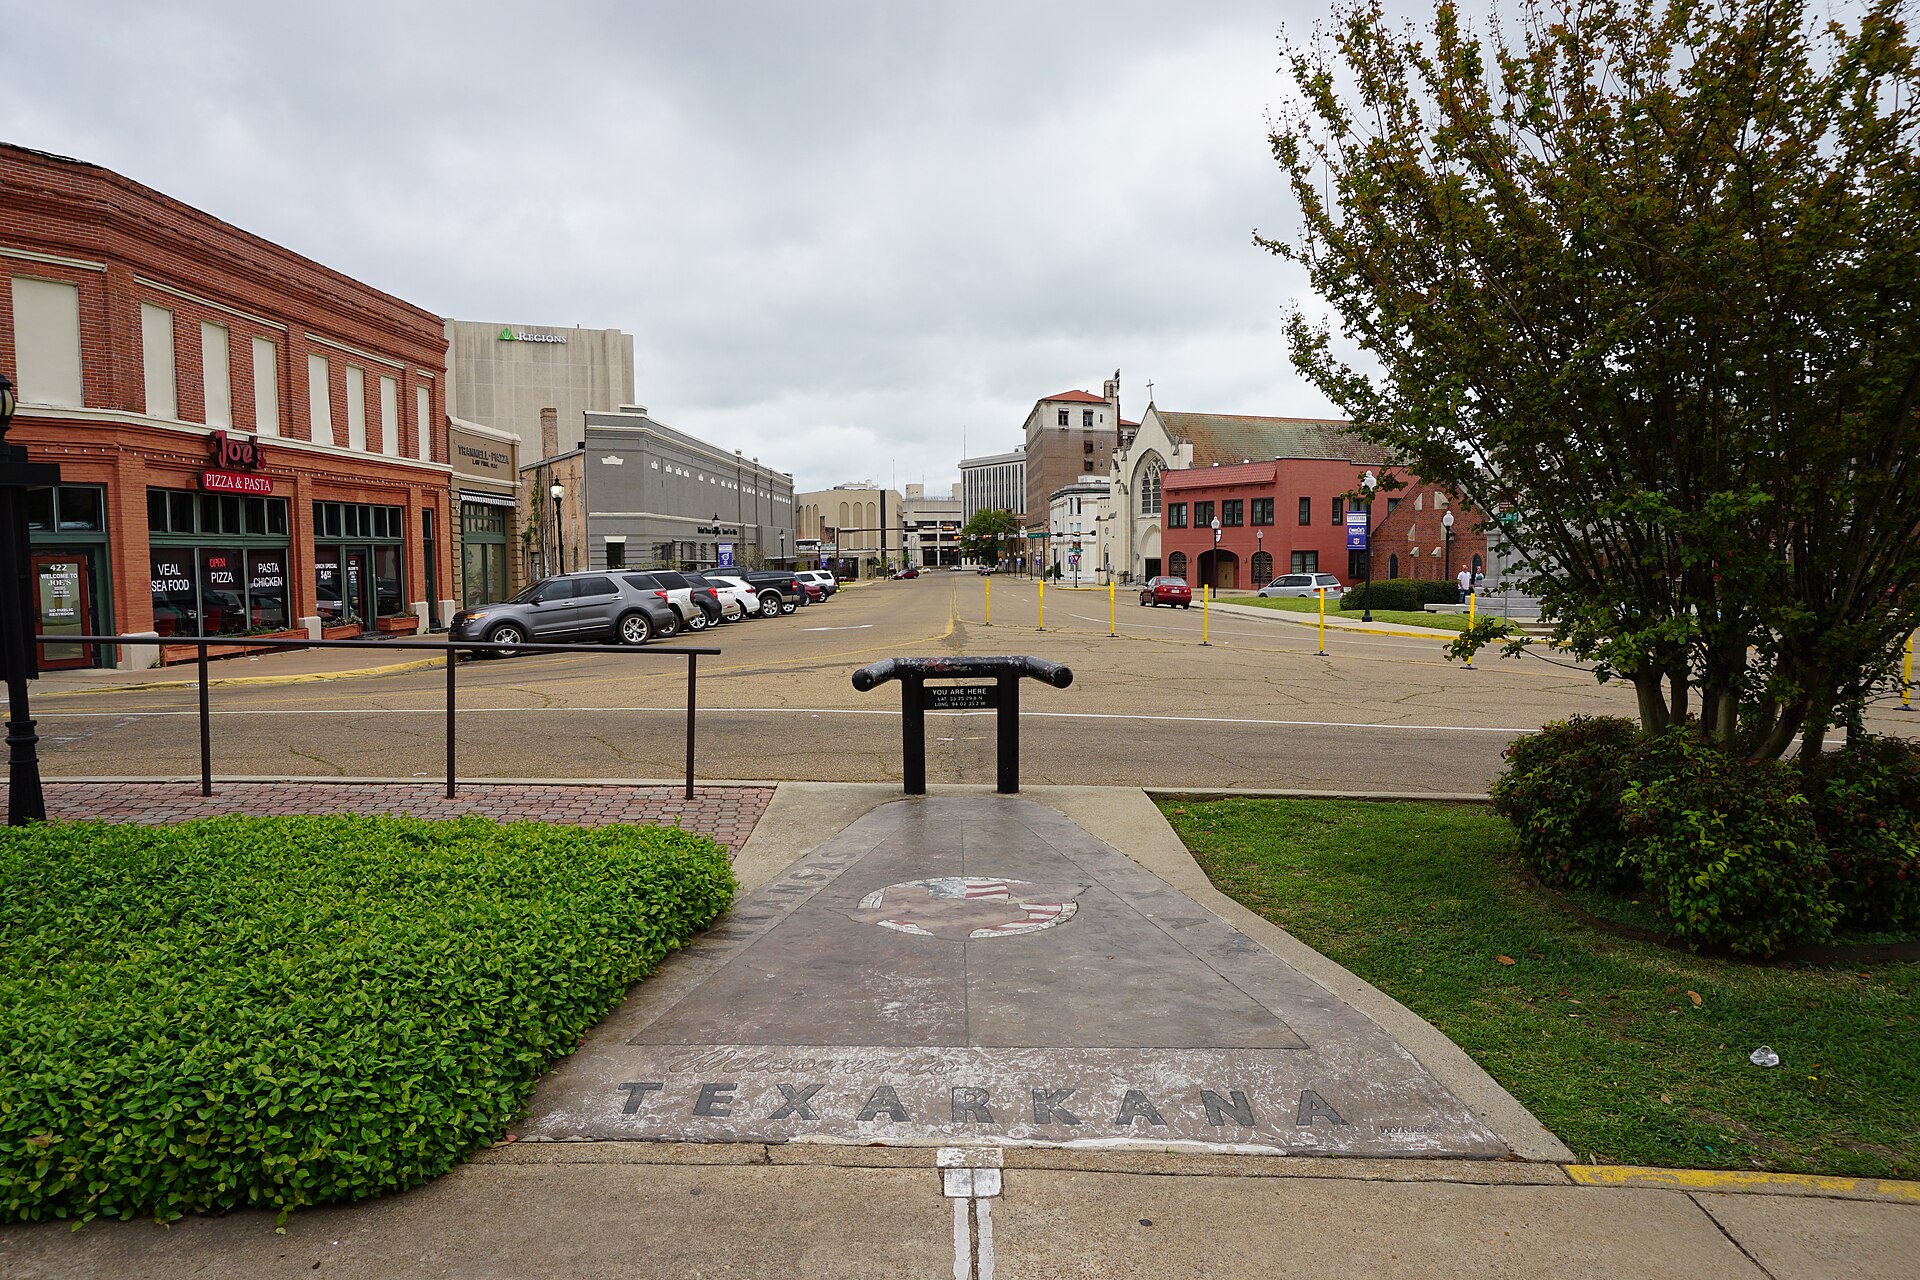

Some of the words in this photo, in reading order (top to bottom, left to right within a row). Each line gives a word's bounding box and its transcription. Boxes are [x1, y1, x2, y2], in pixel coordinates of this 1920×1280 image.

[519, 332, 567, 344] REGIONS
[215, 429, 267, 470] Joe's
[205, 473, 234, 489] PIZZA
[235, 476, 243, 489] &
[244, 477, 271, 492] PASTA
[209, 557, 226, 568] OPEN
[257, 562, 280, 574] PASTA
[157, 563, 182, 576] VEAL
[210, 572, 234, 583] PIZZA
[253, 576, 283, 588] CHICKEN
[151, 580, 168, 592] SEA
[168, 579, 190, 592] FOOD
[669, 1049, 892, 1076] Welcome
[905, 1054, 959, 1076] to
[617, 1081, 1350, 1126] TEXARKANA
